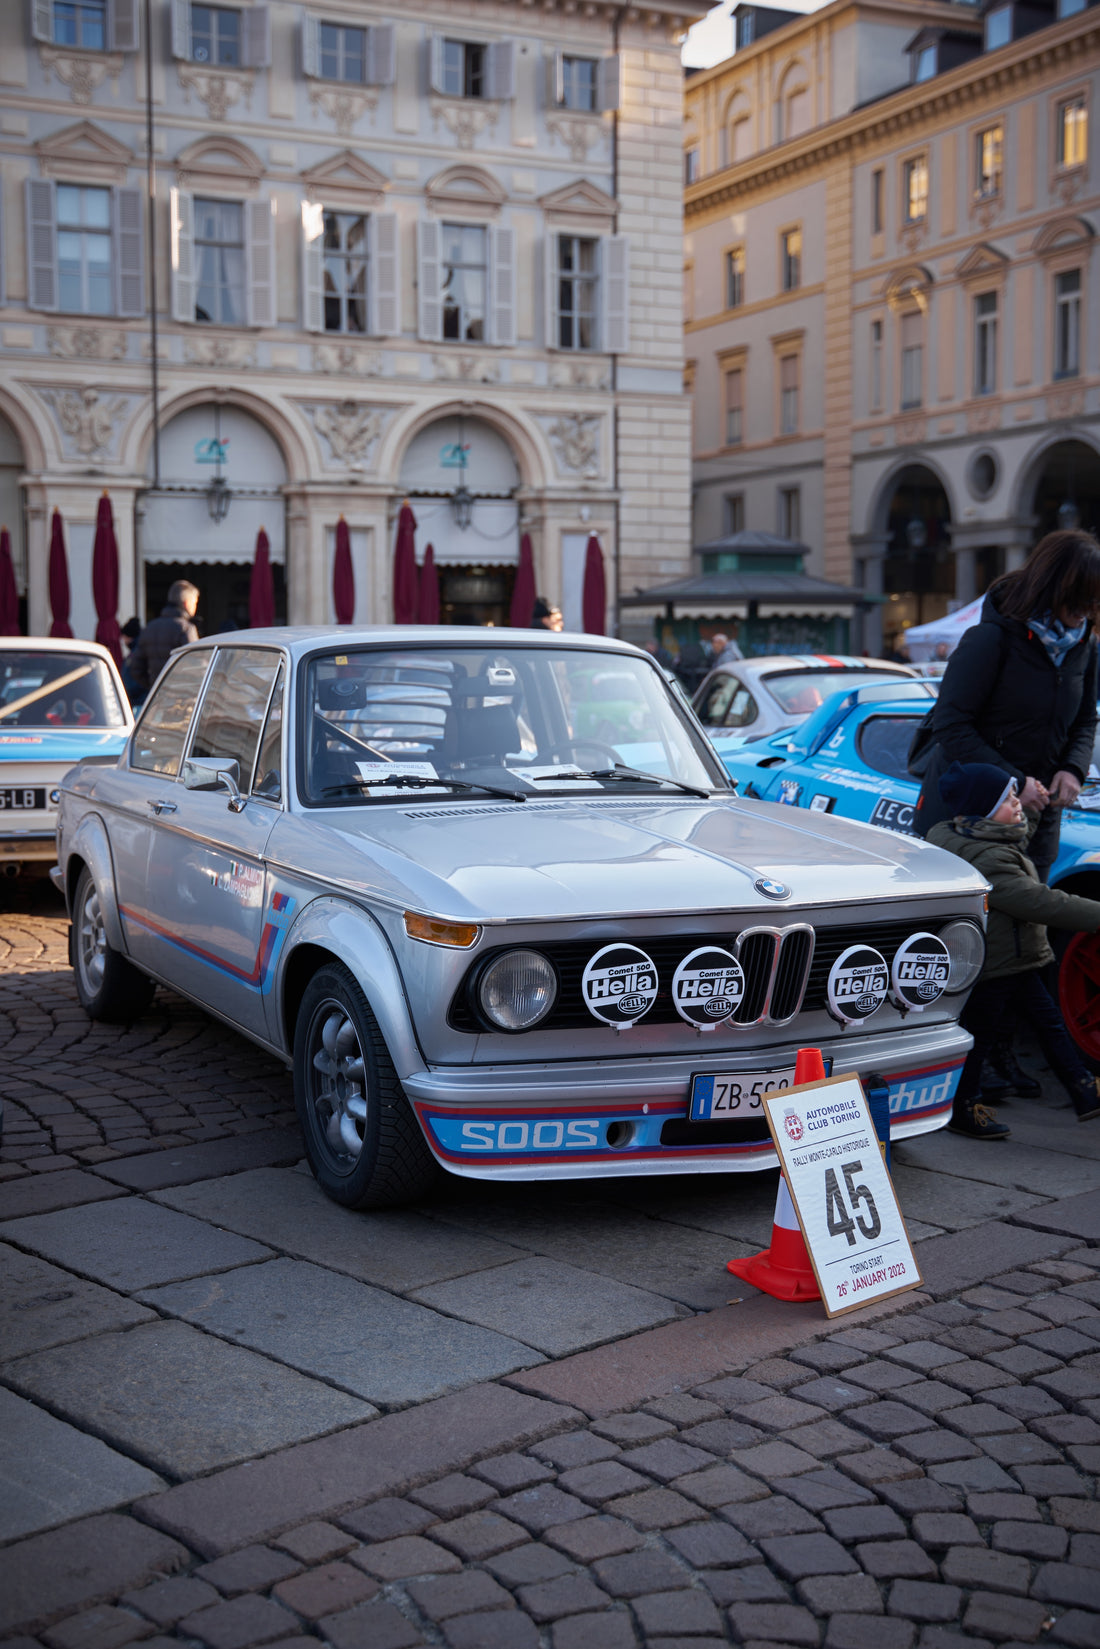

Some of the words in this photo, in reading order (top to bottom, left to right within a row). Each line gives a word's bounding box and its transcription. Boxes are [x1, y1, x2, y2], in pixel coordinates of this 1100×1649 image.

[875, 800, 899, 821] LE
[608, 966, 634, 976] Comet
[636, 963, 651, 972] 500
[699, 970, 723, 978] Comet
[852, 967, 873, 976] Comet
[874, 965, 886, 973] 500
[900, 962, 946, 980] Hella
[591, 974, 652, 999] Hella
[680, 978, 739, 998] Hella
[836, 975, 885, 996] Hella
[620, 996, 647, 1009] HELLA
[707, 1001, 732, 1011] HELLA
[857, 996, 879, 1006] HELLA
[714, 1083, 742, 1111] ZB
[806, 1100, 857, 1120] AUTOMOBILE
[807, 1118, 829, 1131] CLUB
[830, 1110, 861, 1125] TORINO
[792, 1154, 809, 1167] RALLY
[808, 1145, 842, 1163] MONTE-CARLO
[843, 1138, 870, 1153] HISTORIQUE
[825, 1160, 881, 1247] 45
[850, 1260, 869, 1275] TORINO
[868, 1255, 884, 1269] START
[852, 1268, 888, 1292] JANUARY
[888, 1262, 906, 1280] 2023
